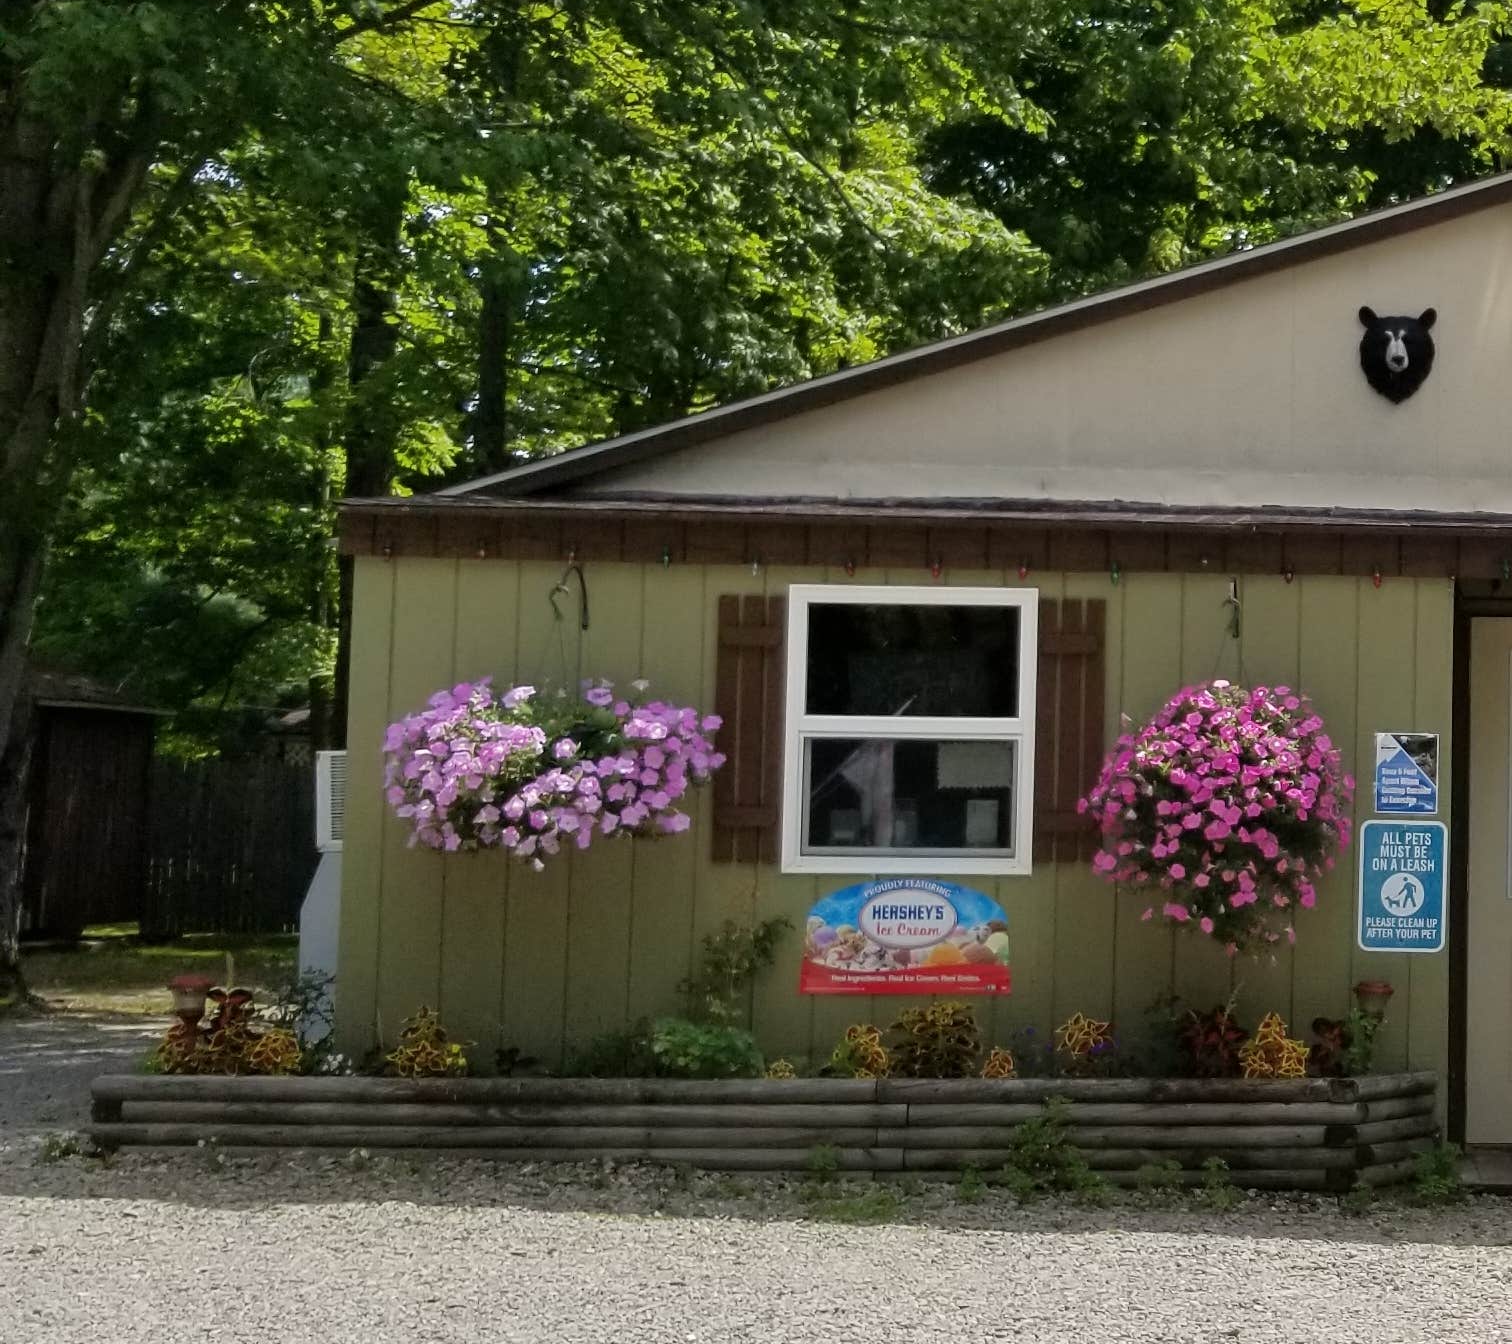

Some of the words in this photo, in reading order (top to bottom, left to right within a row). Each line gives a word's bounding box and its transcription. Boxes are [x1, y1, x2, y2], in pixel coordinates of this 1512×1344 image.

[1382, 831, 1403, 845] ALL
[1405, 832, 1432, 846] PETS
[1380, 845, 1411, 858] MUST
[1414, 846, 1428, 859] BE
[1372, 858, 1388, 871] ON
[1390, 858, 1398, 871] A
[1400, 859, 1435, 872] LEASH
[863, 879, 904, 897] PROUDLY
[905, 879, 953, 897] FEATURING
[872, 904, 944, 920] HERSHEY'S
[1365, 916, 1396, 928] PLEASE
[1398, 917, 1424, 928] CLEAN
[1426, 918, 1438, 928] UP
[876, 922, 892, 936] Ice
[897, 922, 941, 937] Cream
[1366, 928, 1393, 938] AFTER
[1395, 928, 1419, 939] YOUR
[1421, 929, 1437, 940] PET
